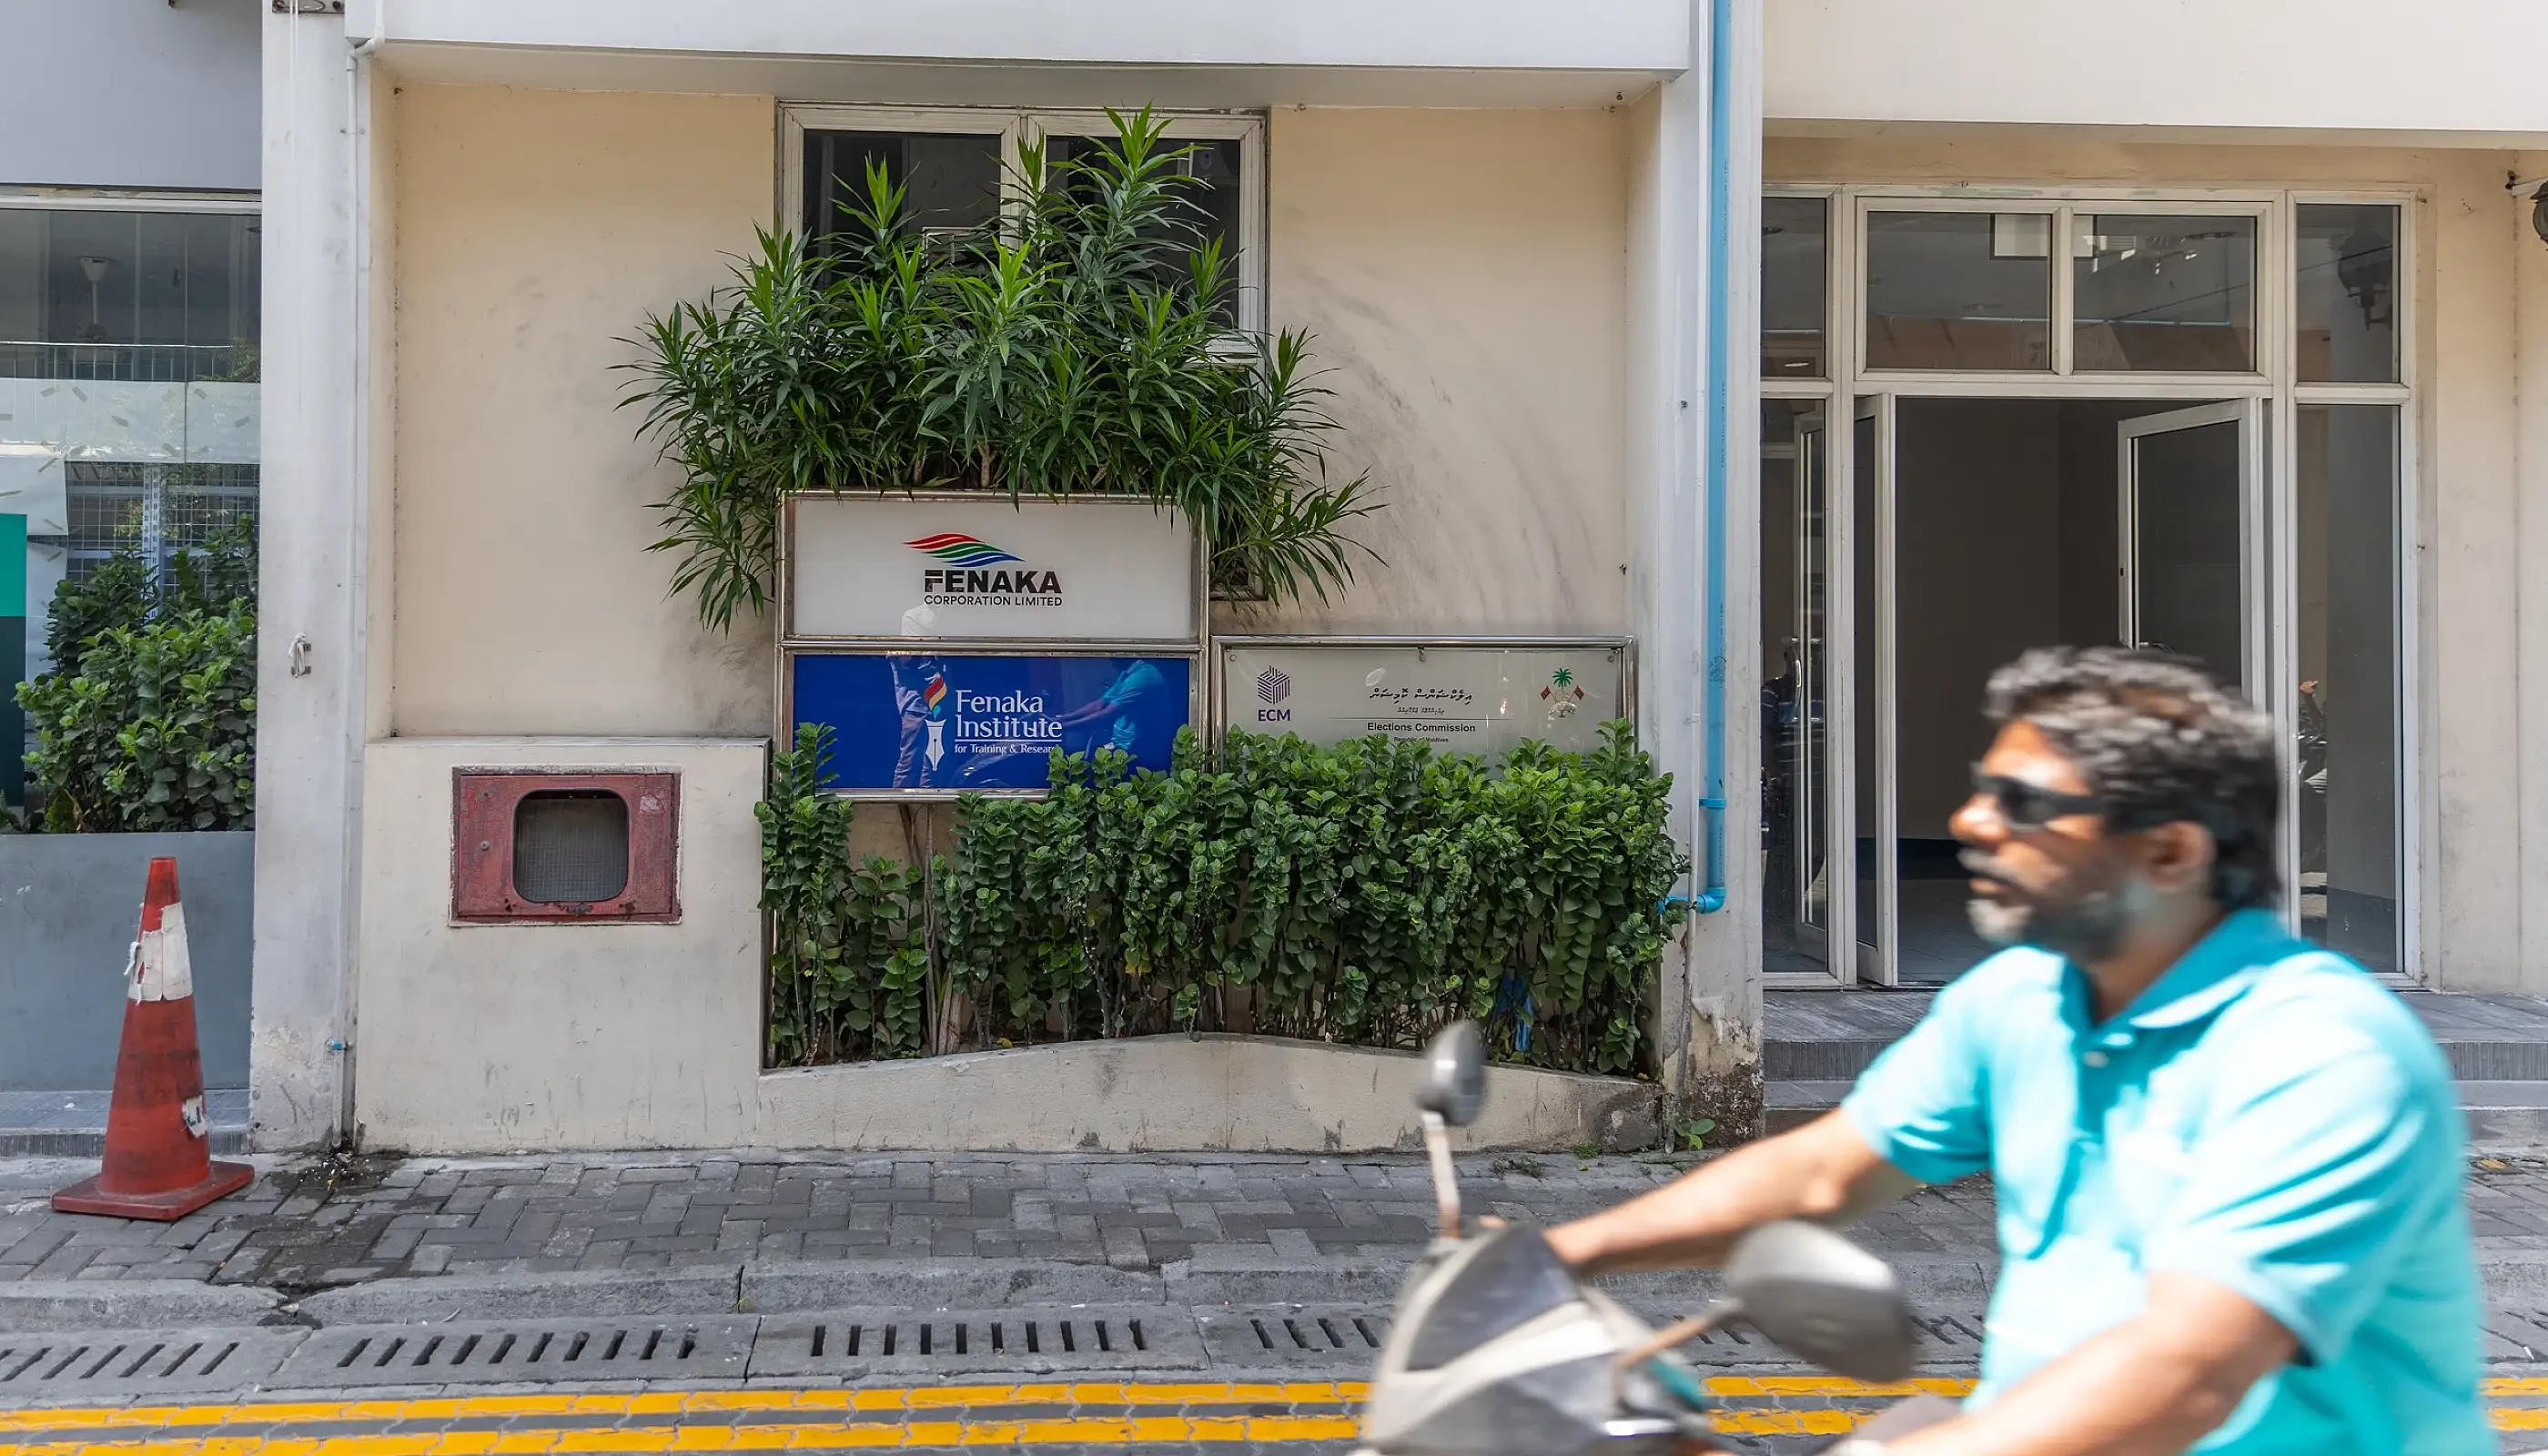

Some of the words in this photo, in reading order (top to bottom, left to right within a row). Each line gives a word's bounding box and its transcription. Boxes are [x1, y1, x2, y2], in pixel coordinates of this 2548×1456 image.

[925, 570, 1063, 593] FENAKA
[924, 595, 1011, 606] CORPORATION
[1015, 596, 1063, 607] LIMITED
[956, 689, 1044, 713] Fenaka
[1258, 709, 1291, 722] ECM
[956, 714, 1063, 738] Institute
[1367, 722, 1412, 732] Elections
[1415, 723, 1476, 733] Commission
[955, 743, 968, 753] for
[970, 743, 1006, 755] Training
[1009, 743, 1019, 753] &
[1020, 743, 1058, 753] Resear
